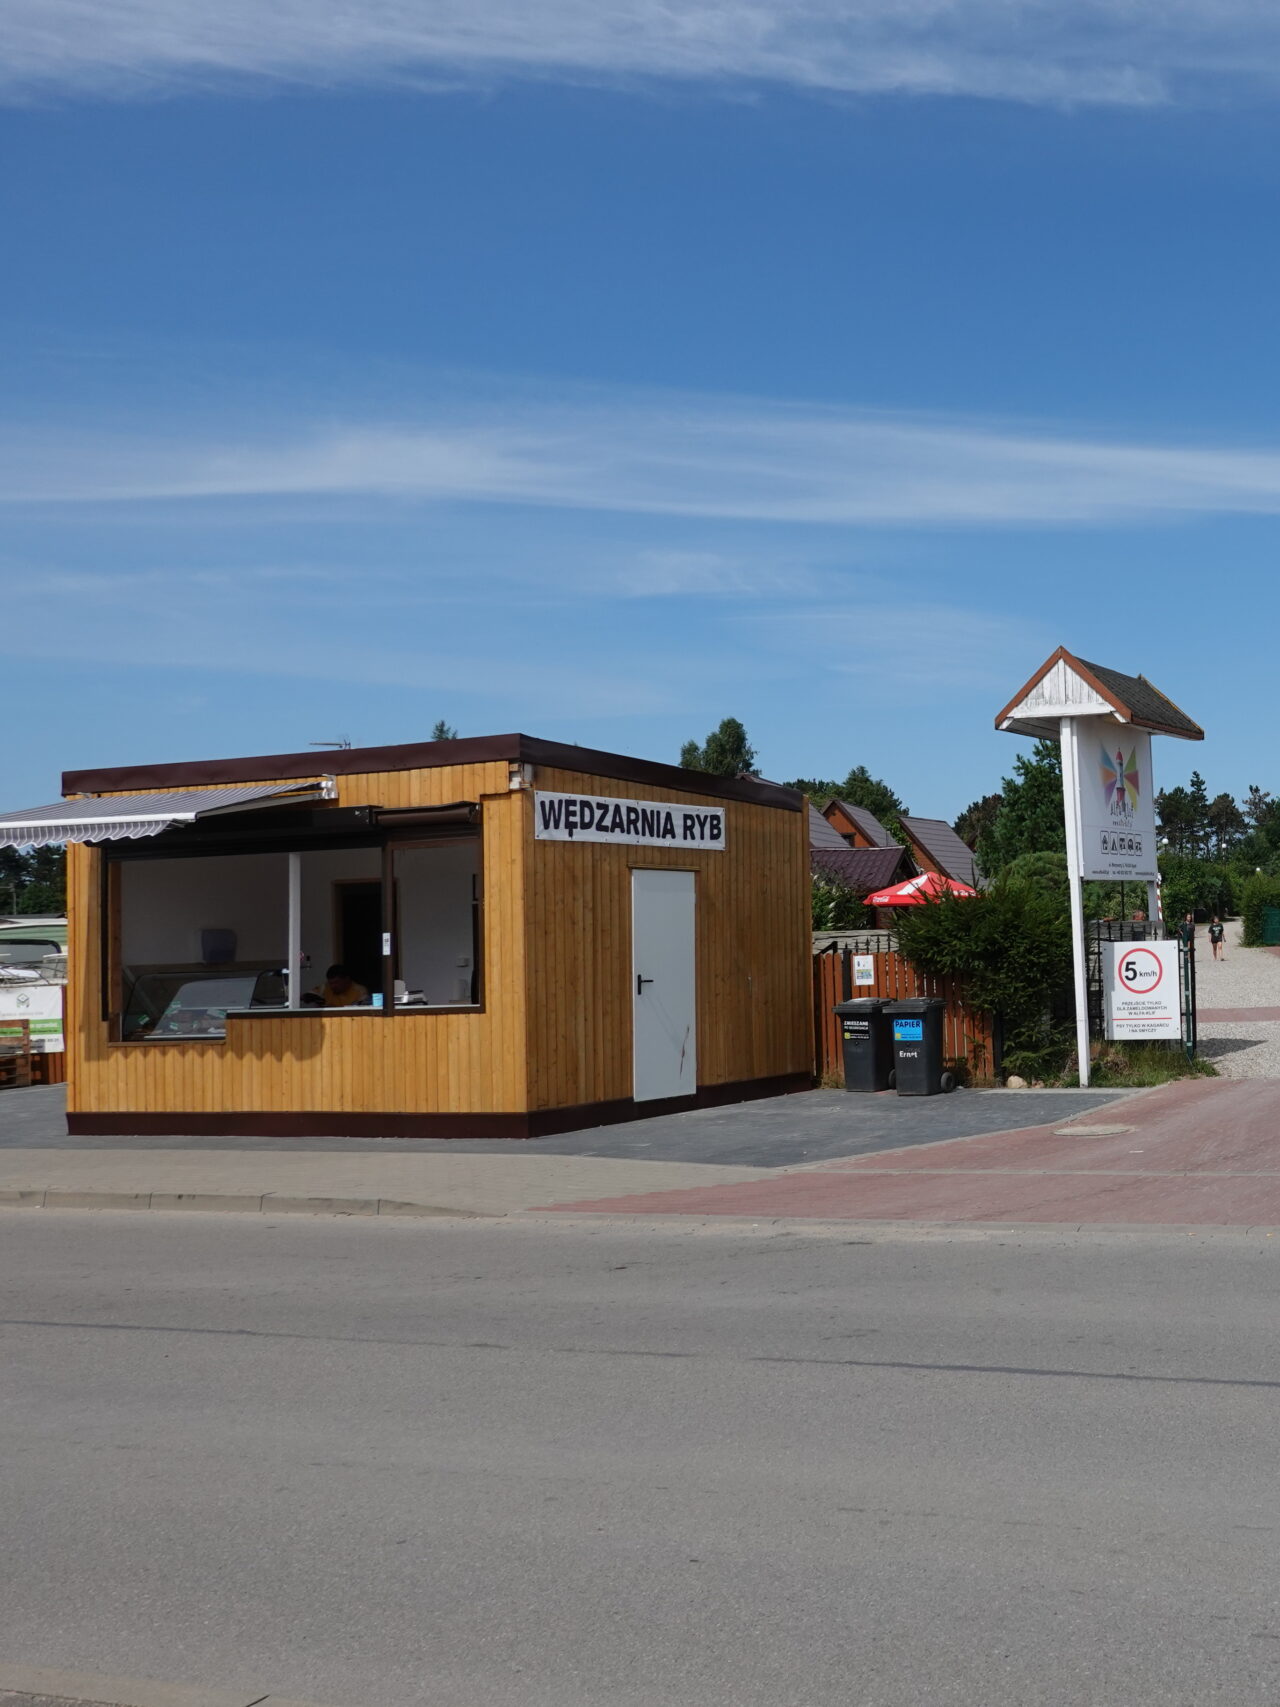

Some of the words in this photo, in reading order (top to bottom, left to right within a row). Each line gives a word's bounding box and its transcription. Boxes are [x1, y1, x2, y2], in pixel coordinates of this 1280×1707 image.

[540, 799, 676, 840] WĘDZARNIA
[682, 813, 722, 841] RYB
[1124, 961, 1138, 982] 5
[895, 1020, 921, 1029] PAPIER
